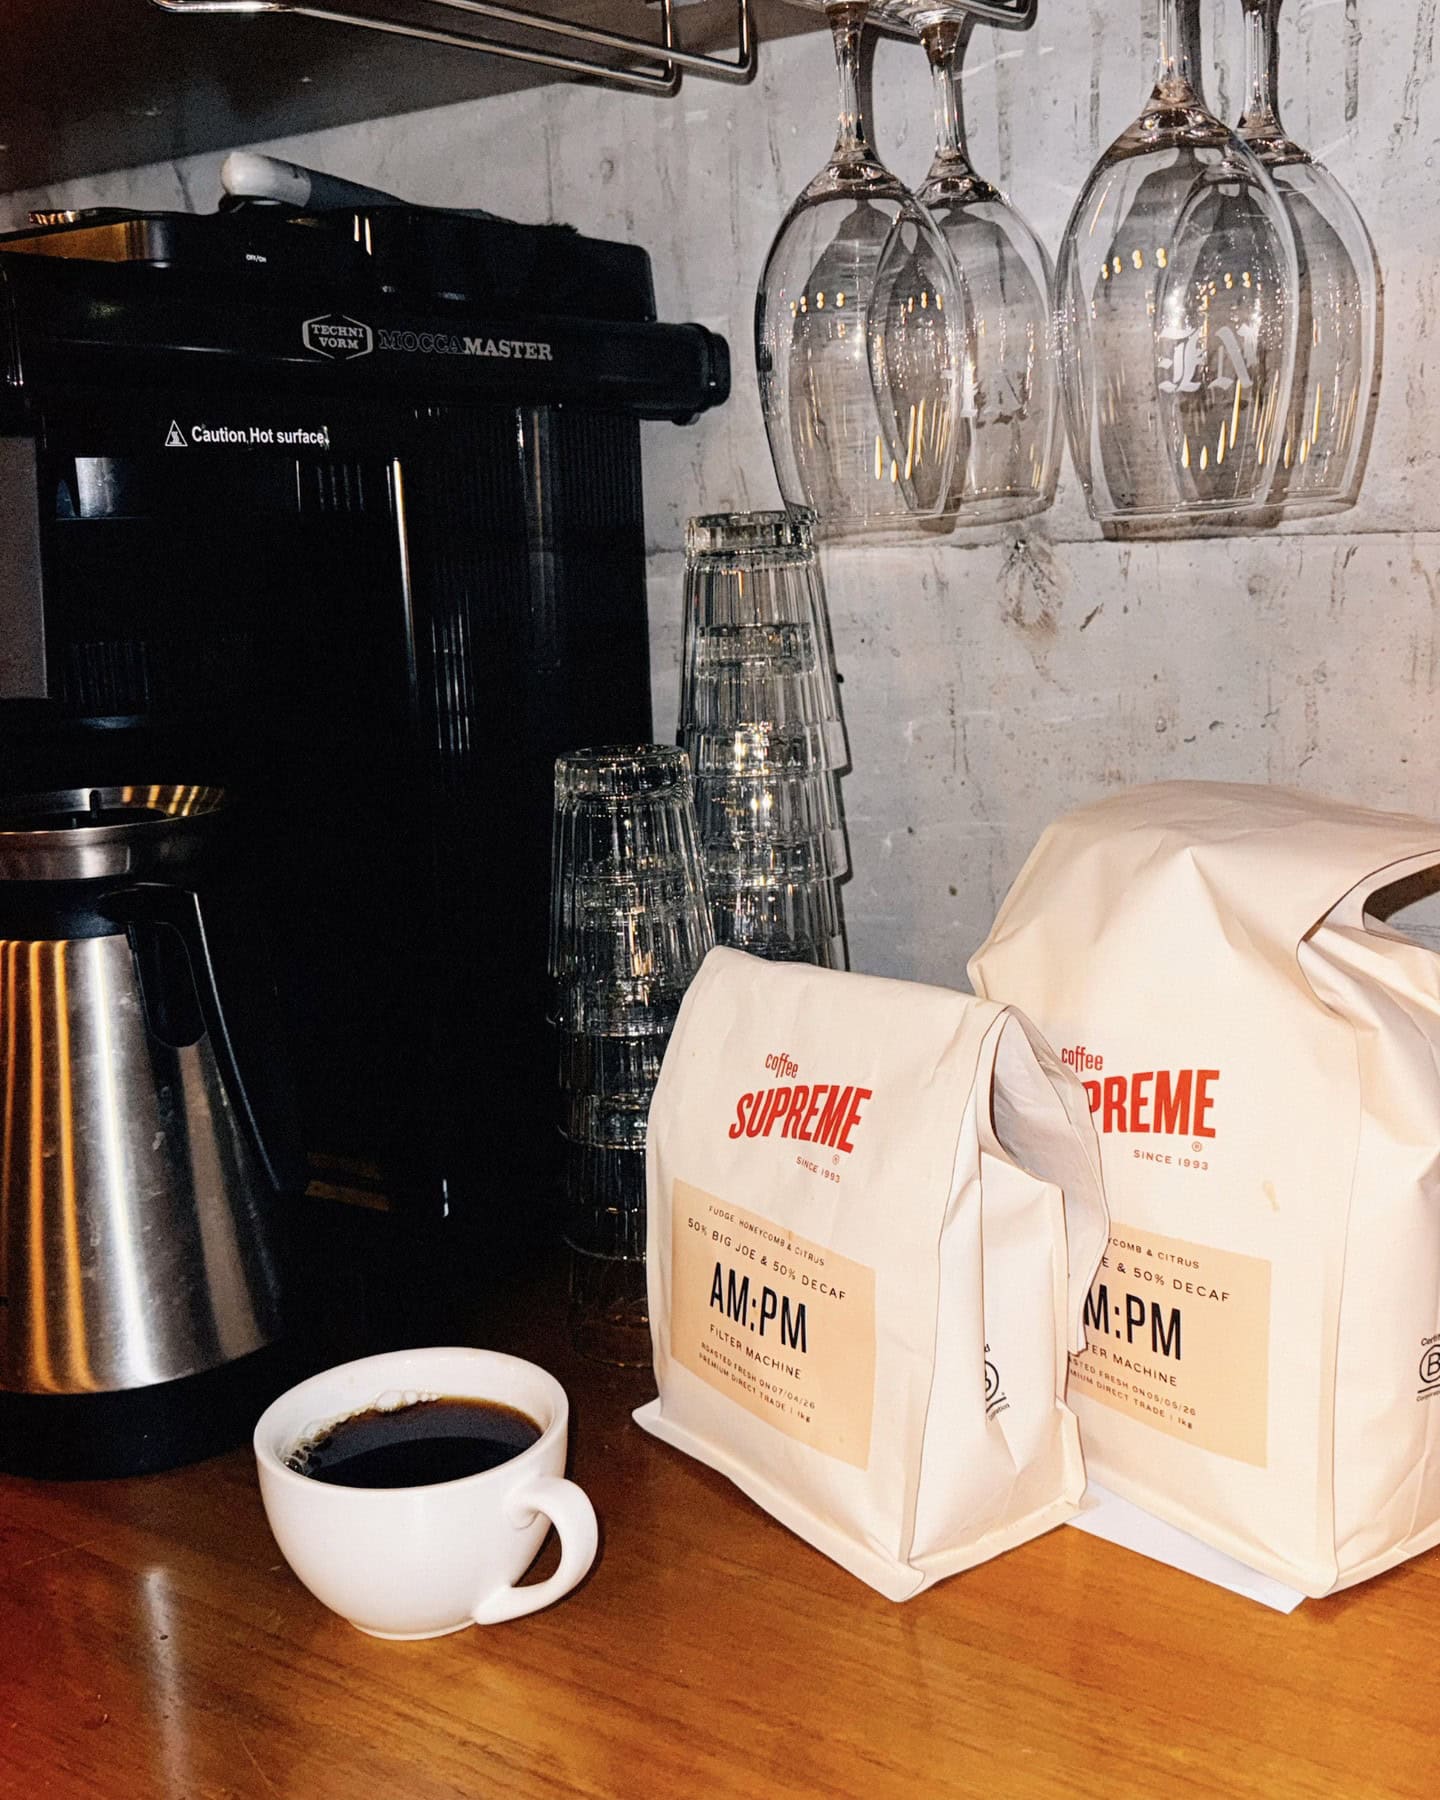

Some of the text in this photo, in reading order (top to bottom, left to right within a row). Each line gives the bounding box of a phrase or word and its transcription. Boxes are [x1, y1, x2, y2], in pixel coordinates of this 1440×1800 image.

[311, 324, 364, 338] TECHNI
[319, 336, 359, 349] VORM
[250, 427, 274, 443] Hot
[765, 1053, 799, 1079] coffee
[1061, 1046, 1104, 1073] coffee
[728, 1084, 873, 1154] SUPREME
[1082, 1069, 1220, 1138] PREME
[796, 1156, 841, 1183] SINCE 1993
[1133, 1149, 1209, 1171] SINCE 1993
[709, 1205, 735, 1223] FUDGE
[739, 1219, 785, 1247] HONEYCOMB
[794, 1246, 825, 1266] CITRUS
[688, 1217, 847, 1300] 50% BIG JOE & 50% DECAF
[1146, 1248, 1153, 1257] &
[1157, 1251, 1200, 1269] CITRUS
[1117, 1262, 1126, 1274] &
[1133, 1267, 1165, 1286] 50%
[1173, 1279, 1231, 1302] DECAF
[709, 1261, 807, 1354] AM:PM
[1083, 1284, 1181, 1361] M:PM
[701, 1341, 732, 1367] ROASTED
[734, 1363, 757, 1382] FRESH
[710, 1324, 801, 1380] FILTER MACHINE
[1113, 1353, 1178, 1387] MACHINE
[699, 1351, 729, 1377] PREMIUM
[731, 1374, 756, 1394] DIRECT
[760, 1390, 786, 1412] TRADE
[1070, 1369, 1094, 1385] MIUM
[1096, 1380, 1129, 1401] DIRECT
[1133, 1398, 1165, 1418] TRADE
[1072, 1358, 1096, 1374] STED
[1099, 1370, 1129, 1390] FRESH
